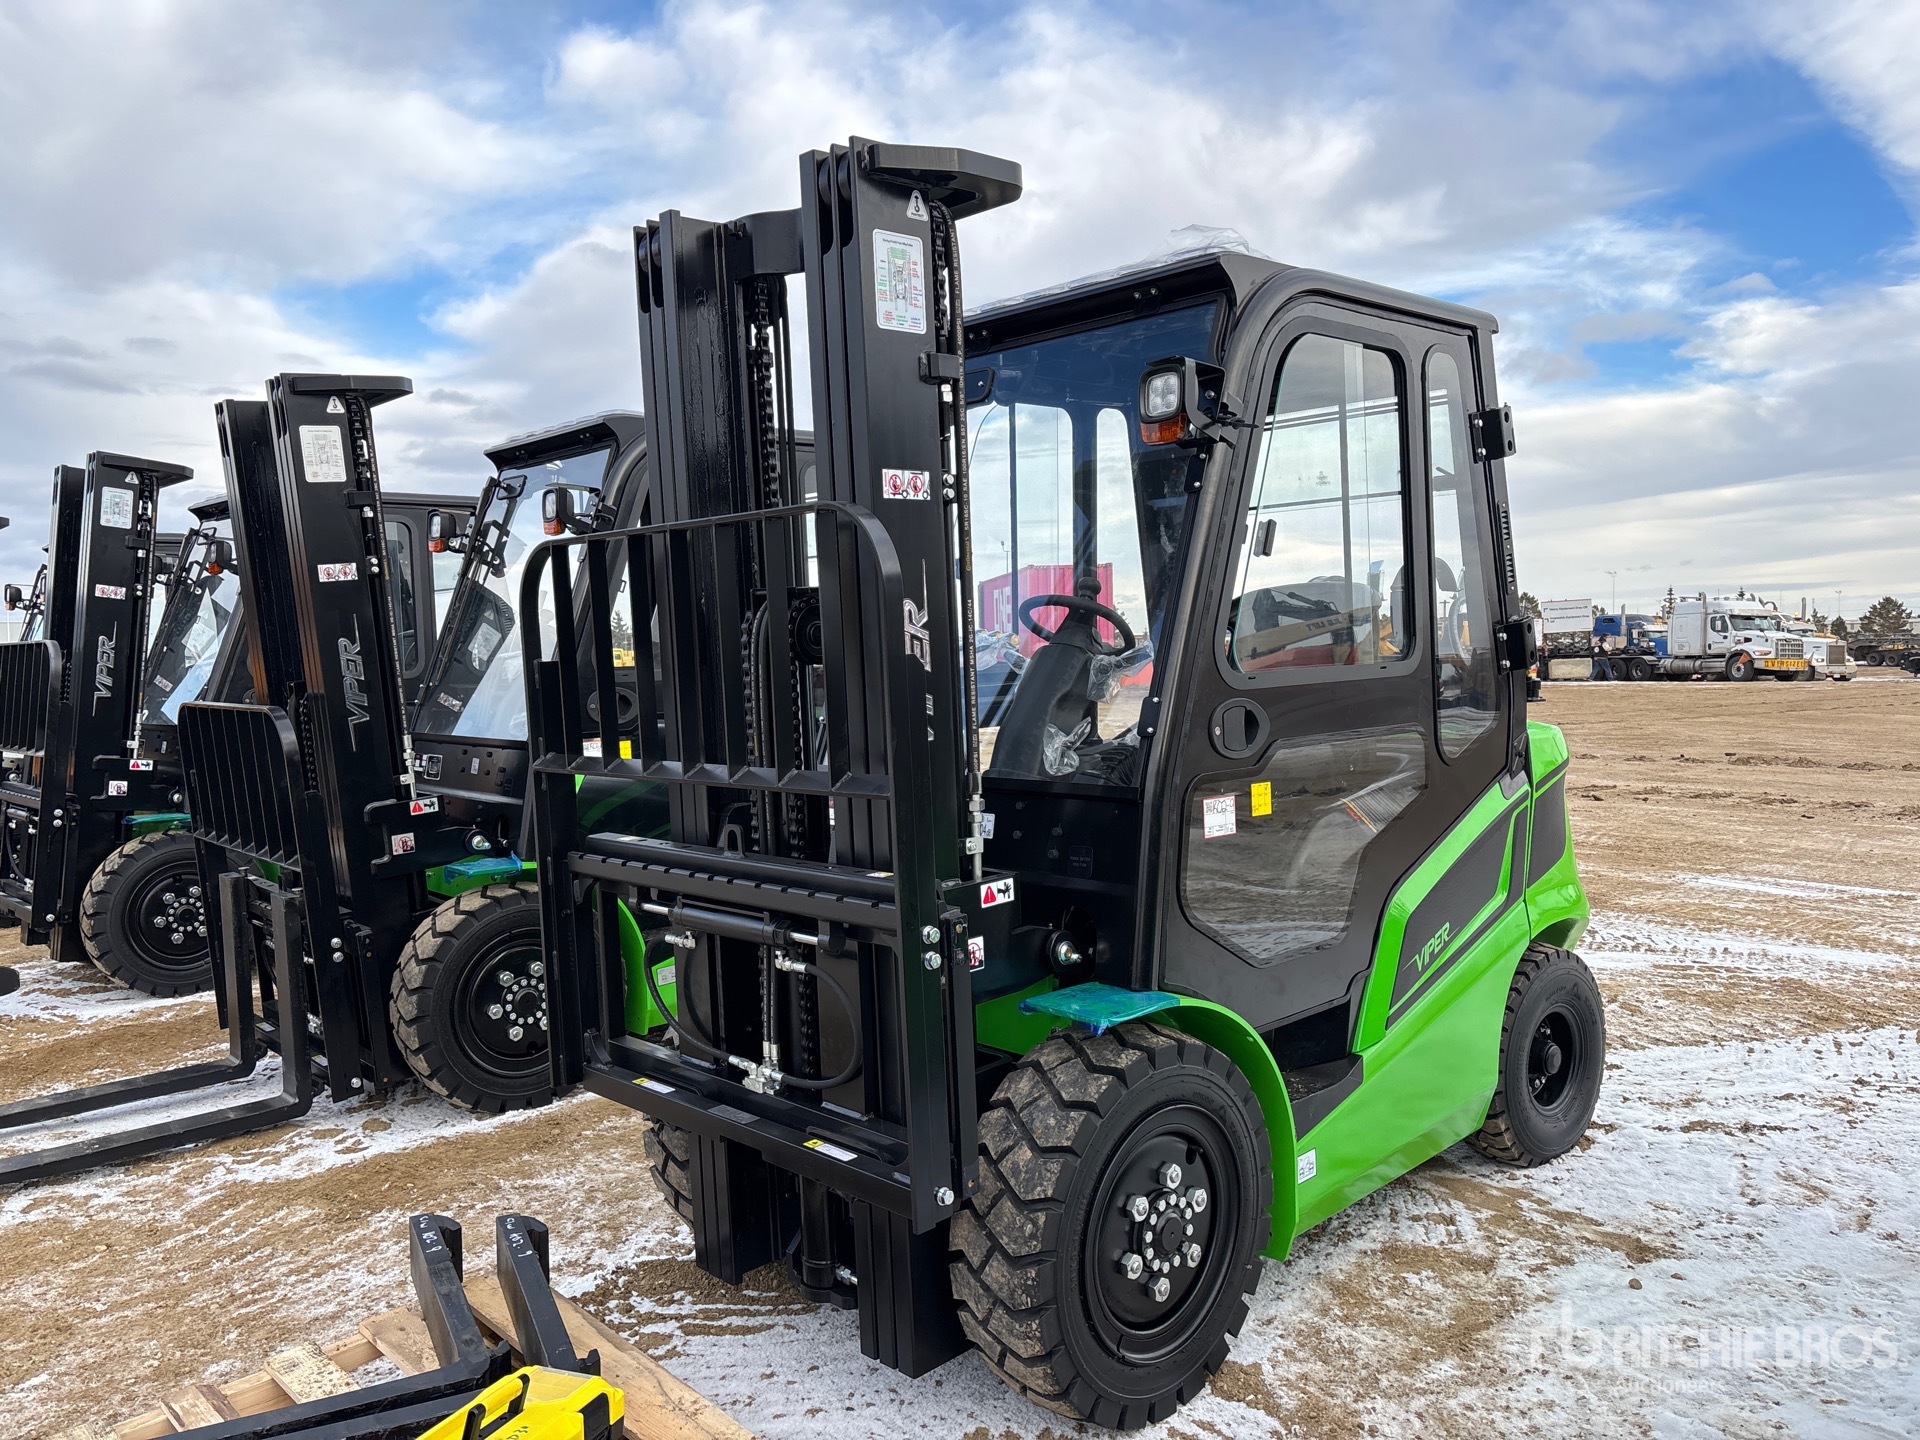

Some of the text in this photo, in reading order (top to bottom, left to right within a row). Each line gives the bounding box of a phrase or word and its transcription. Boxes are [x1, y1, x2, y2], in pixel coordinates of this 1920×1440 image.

[949, 228, 958, 268] RESISTANT
[92, 620, 117, 717] VIPER
[338, 613, 371, 752] VIPER
[1402, 922, 1461, 973] VIPER
